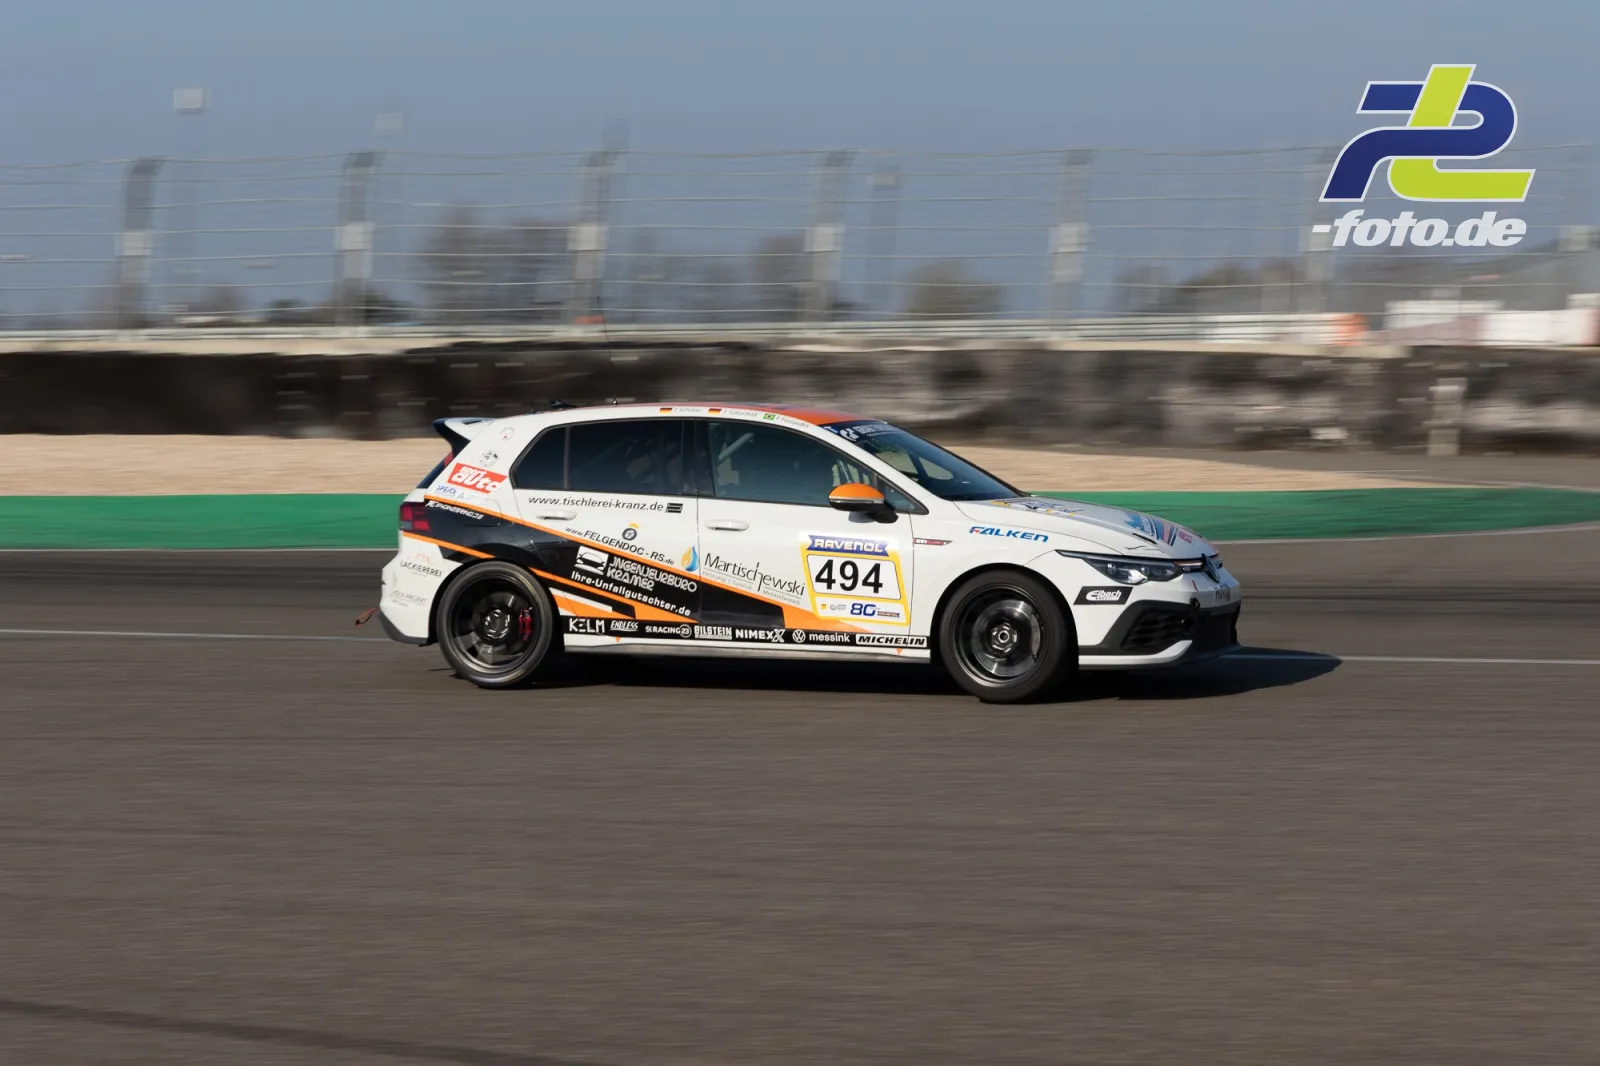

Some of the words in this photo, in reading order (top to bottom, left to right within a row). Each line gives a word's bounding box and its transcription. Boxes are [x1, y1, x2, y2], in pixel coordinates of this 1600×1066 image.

[451, 471, 500, 492] auto
[528, 496, 664, 512] www.tischlerei-kranz.de
[969, 526, 1049, 543] FALKEN
[814, 538, 884, 553] RAVENOL
[704, 553, 806, 596] Martischewski
[815, 559, 884, 594] 494
[570, 571, 692, 617] Ihre-Unfallgutachter.de
[1086, 589, 1122, 601] Eibach
[568, 617, 605, 634] KELM
[610, 620, 639, 631] ENDLESS
[693, 625, 732, 636] BILSTEIN
[808, 632, 851, 643] messink
[857, 635, 925, 646] MICHELIN
